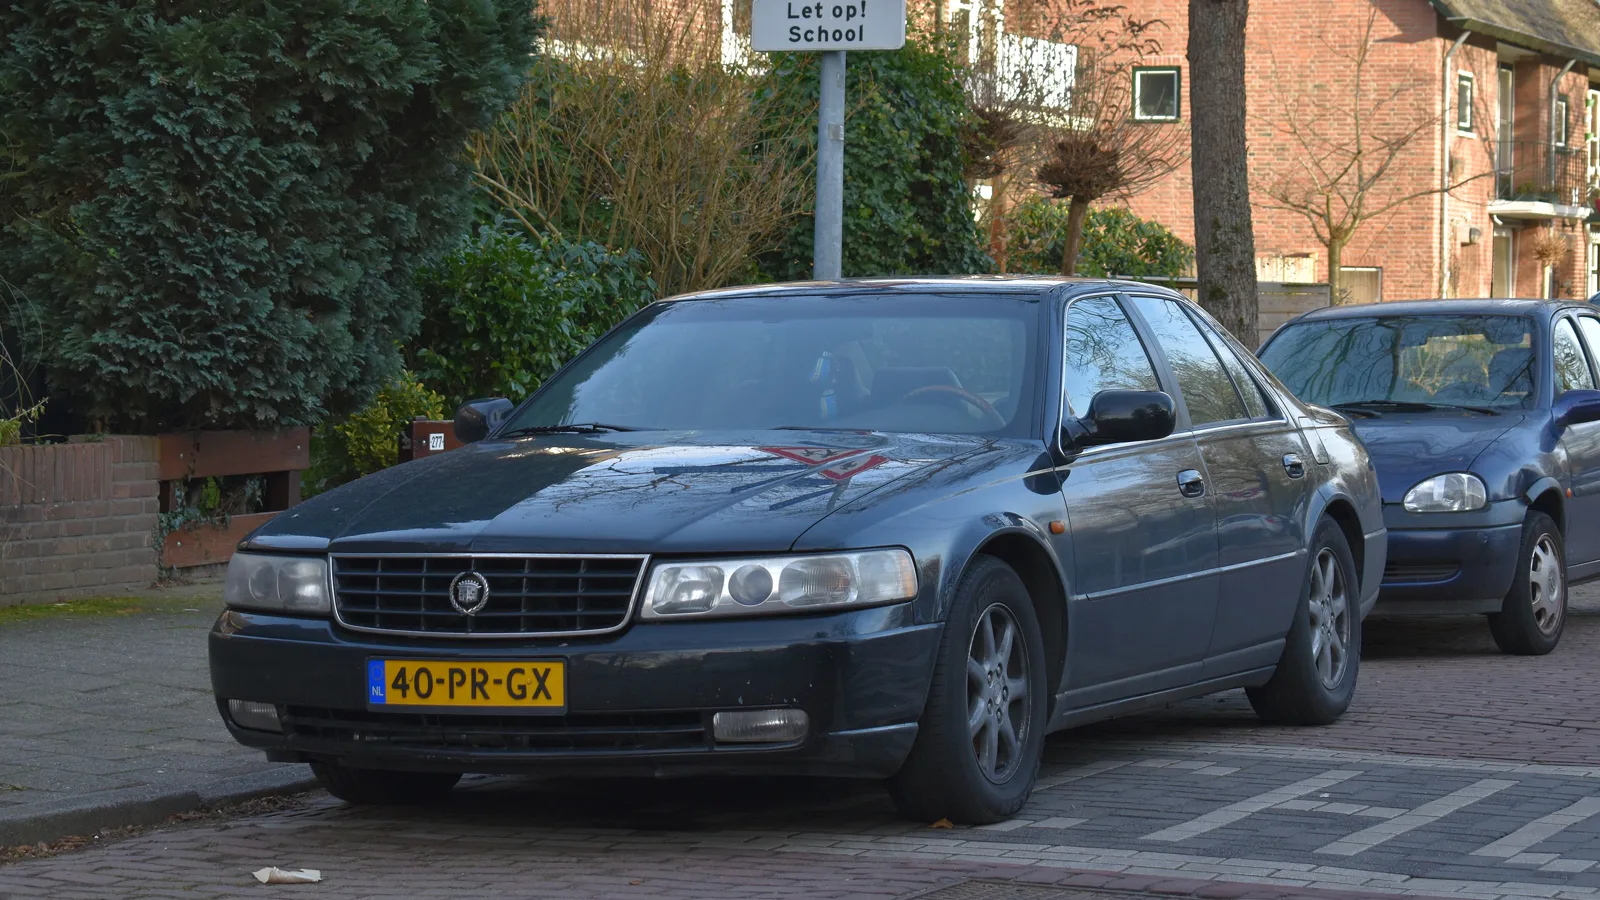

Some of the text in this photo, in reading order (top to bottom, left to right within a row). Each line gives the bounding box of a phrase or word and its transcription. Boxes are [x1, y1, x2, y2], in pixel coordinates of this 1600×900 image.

[788, 0, 866, 21] Let op!
[788, 25, 864, 43] School
[431, 435, 443, 448] 277
[371, 686, 384, 697] NL
[391, 666, 552, 700] 40-PR-GX
